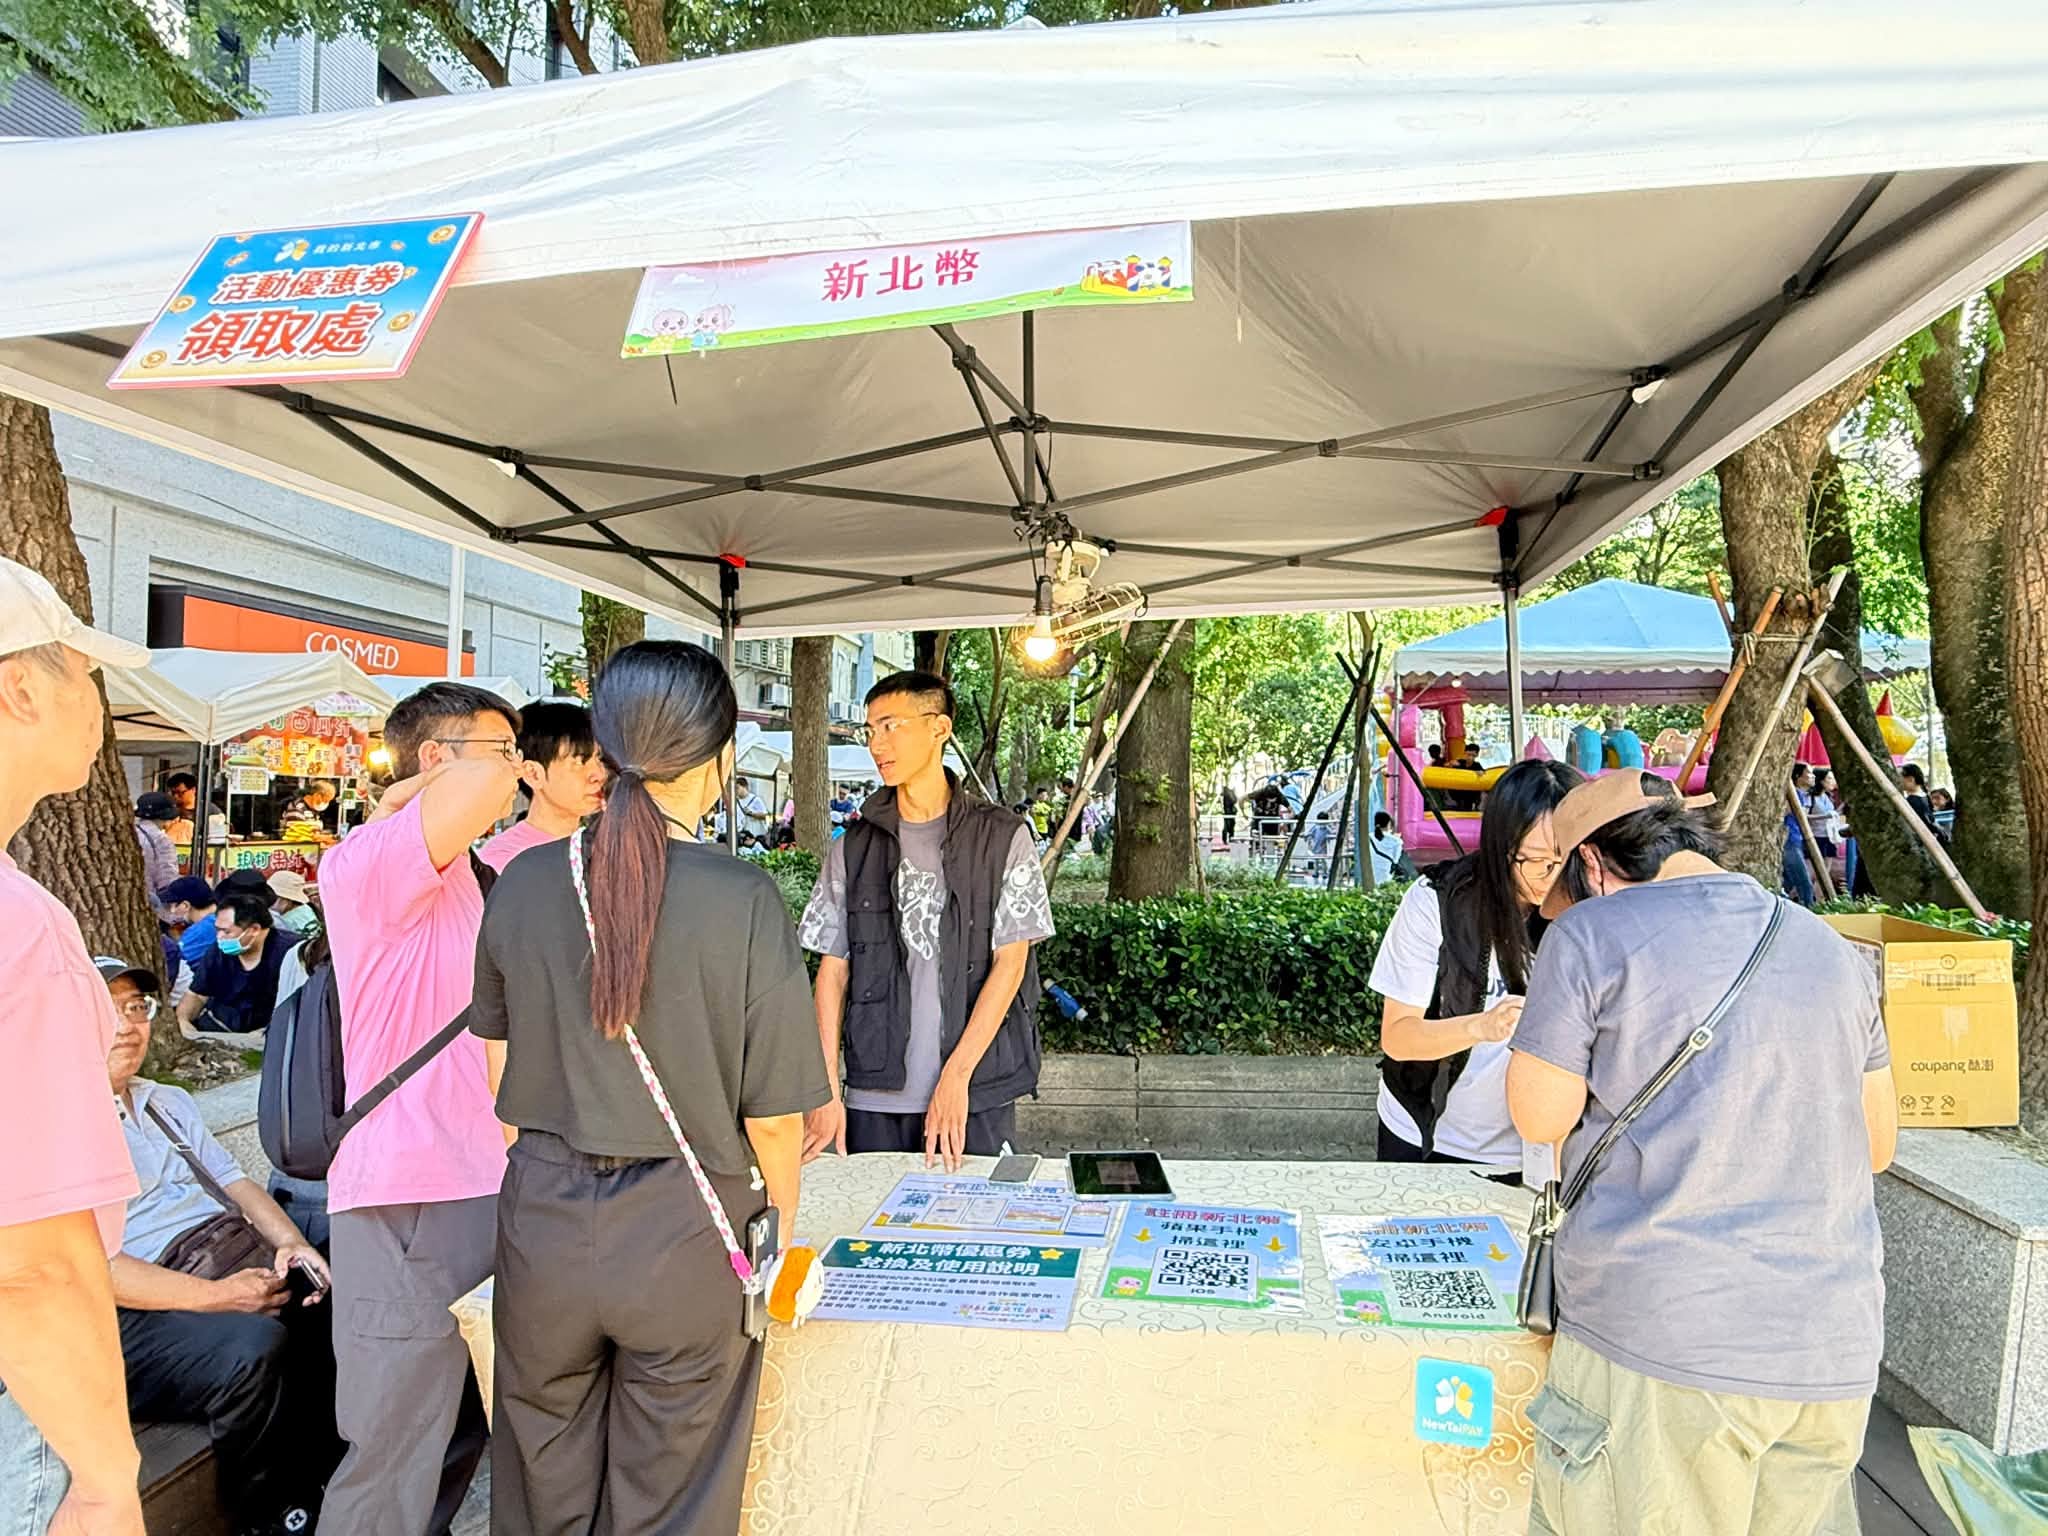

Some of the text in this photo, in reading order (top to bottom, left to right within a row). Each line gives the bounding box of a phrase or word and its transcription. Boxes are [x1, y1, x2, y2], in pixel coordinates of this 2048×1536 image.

[821, 248, 981, 302] 新北幣
[212, 264, 402, 303] 活動優惠券
[175, 303, 381, 362] 領取處
[305, 631, 399, 670] COSMED
[1910, 1061, 1966, 1074] coupang
[1161, 1221, 1259, 1237] 蘋果手機
[1170, 1235, 1246, 1249] 掃這裡
[1368, 1236, 1474, 1249] 安卓手機
[878, 1242, 1032, 1259] 新北幣優惠券
[1385, 1251, 1469, 1264] 掃這裡
[855, 1256, 1041, 1276] 兌換及使用說明
[1422, 1311, 1486, 1320] Android
